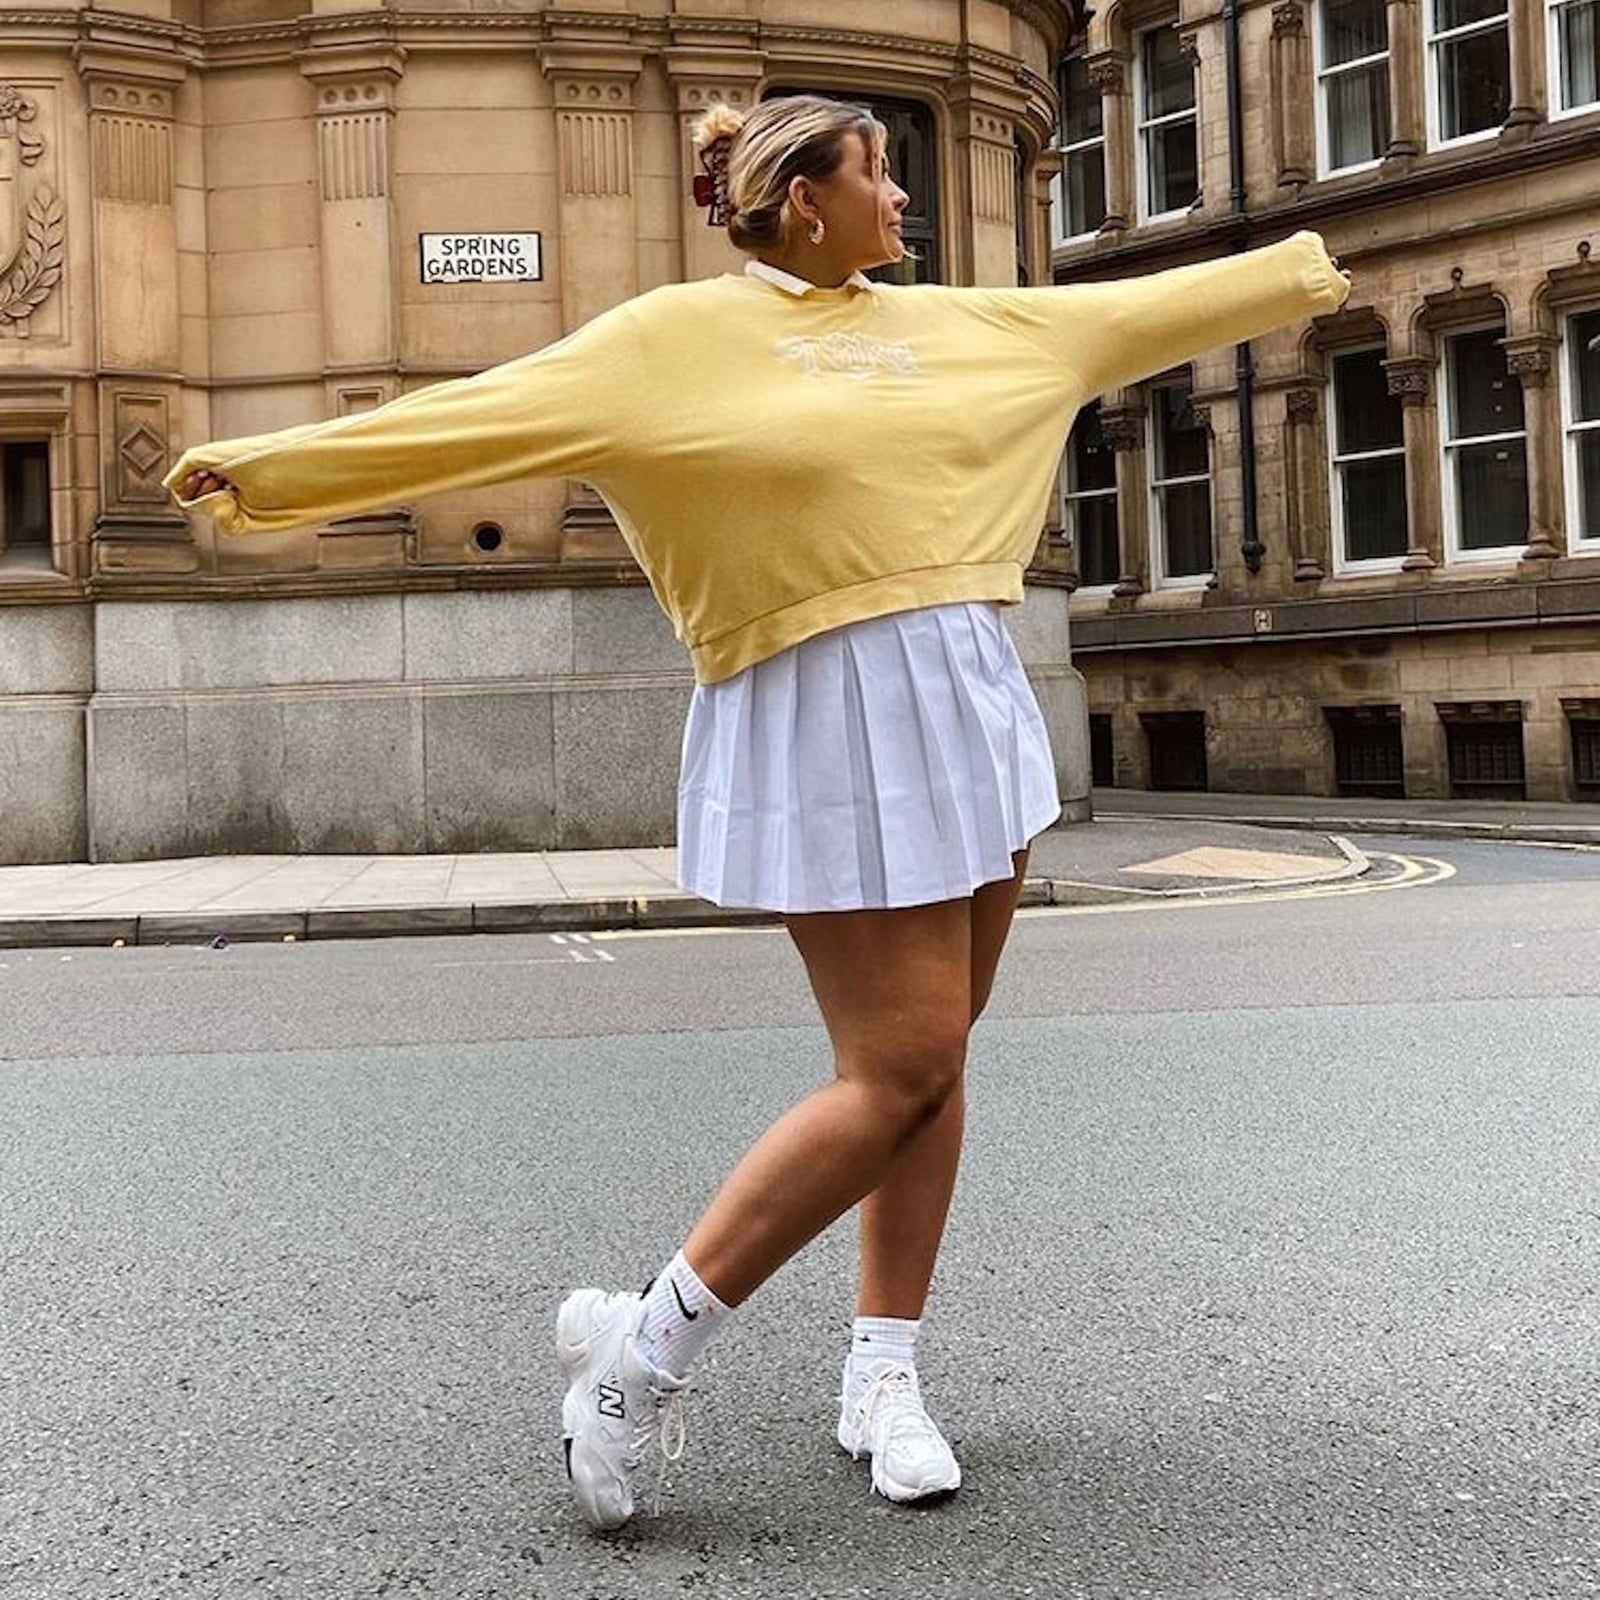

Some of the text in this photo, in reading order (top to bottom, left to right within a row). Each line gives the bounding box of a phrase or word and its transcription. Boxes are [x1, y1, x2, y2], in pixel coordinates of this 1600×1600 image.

[441, 238, 520, 256] SPRING
[427, 258, 527, 276] GARDENS
[599, 1384, 625, 1418] N
